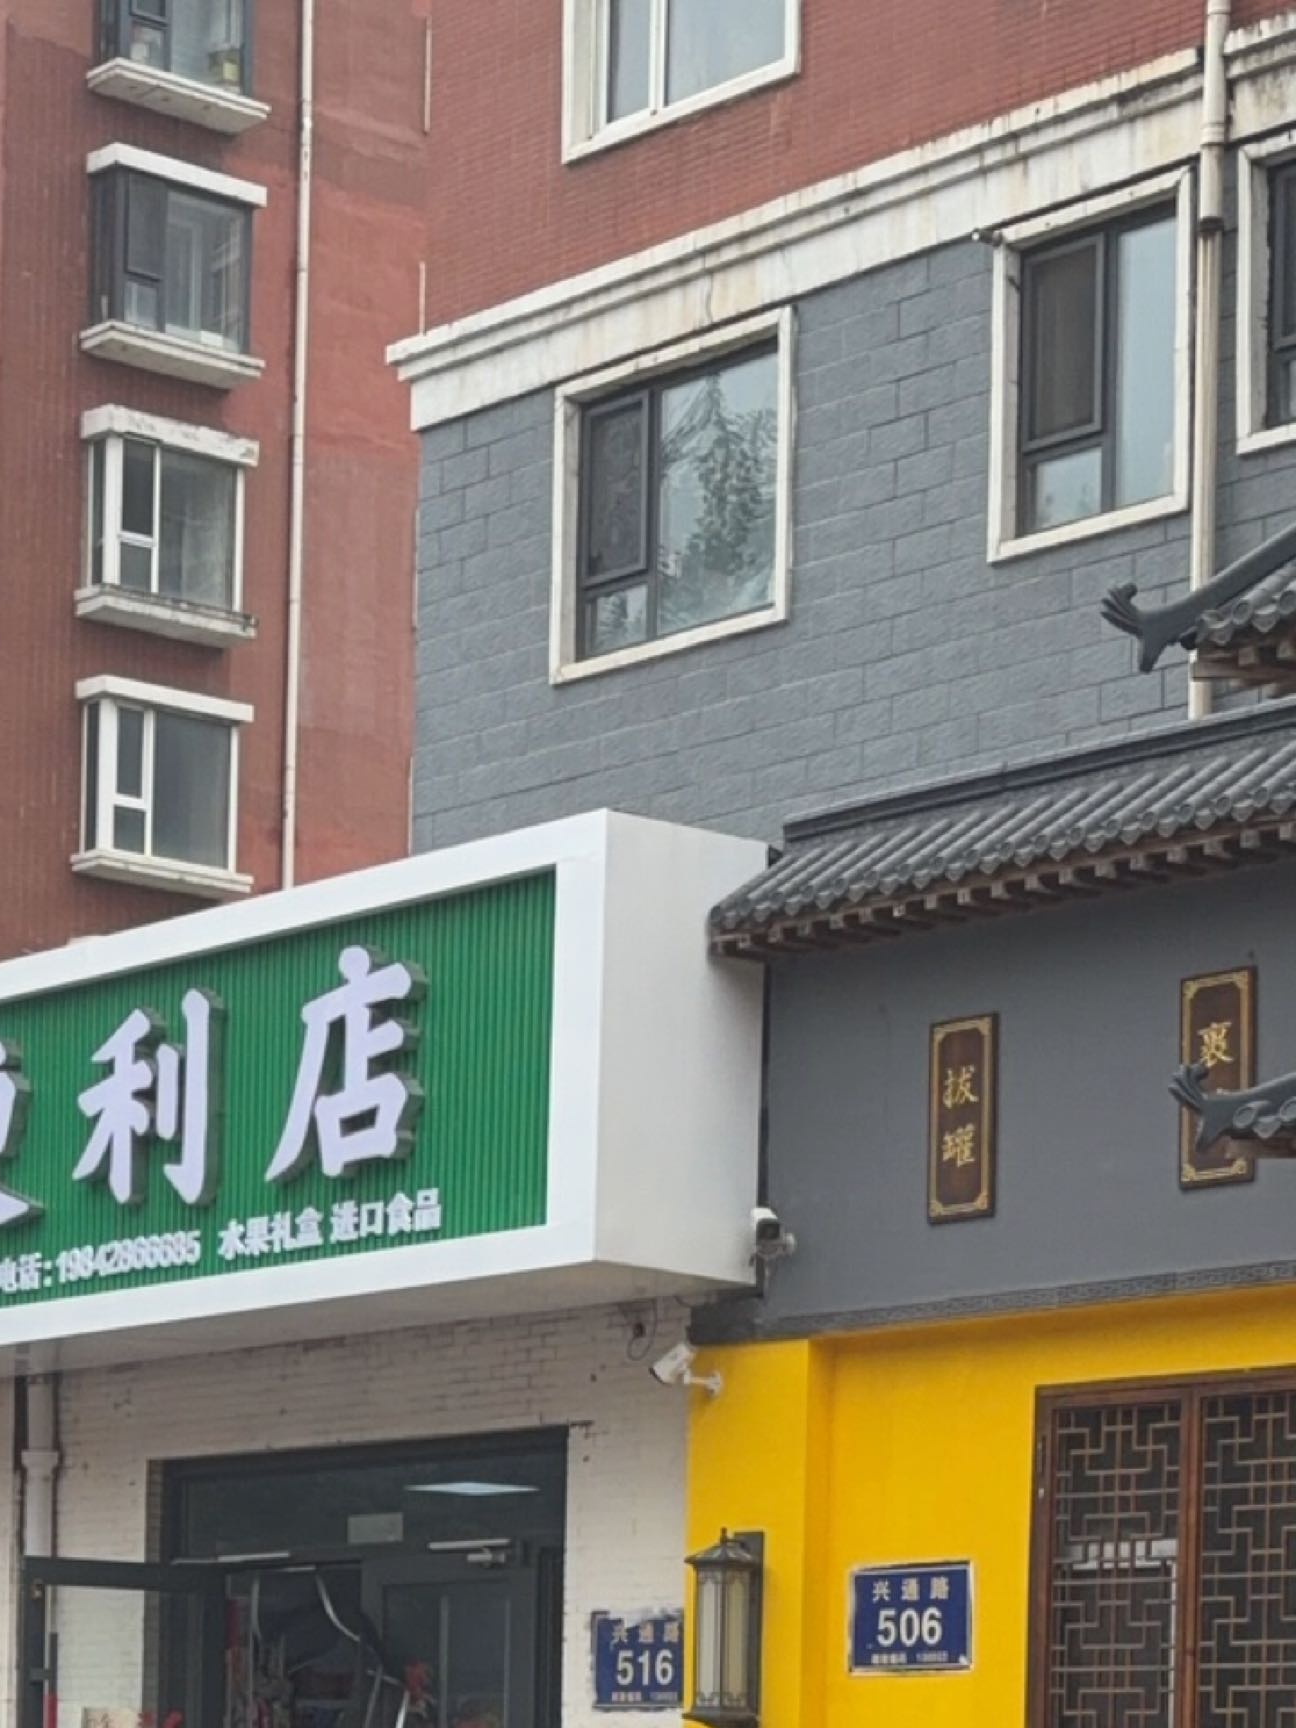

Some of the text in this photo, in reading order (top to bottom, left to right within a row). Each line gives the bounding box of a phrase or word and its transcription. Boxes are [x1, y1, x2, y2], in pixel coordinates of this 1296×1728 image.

[218, 1206, 325, 1260] 水果礼盒
[330, 1187, 442, 1244] 进口食品
[876, 1606, 943, 1647] 506
[616, 1649, 673, 1686] 516
